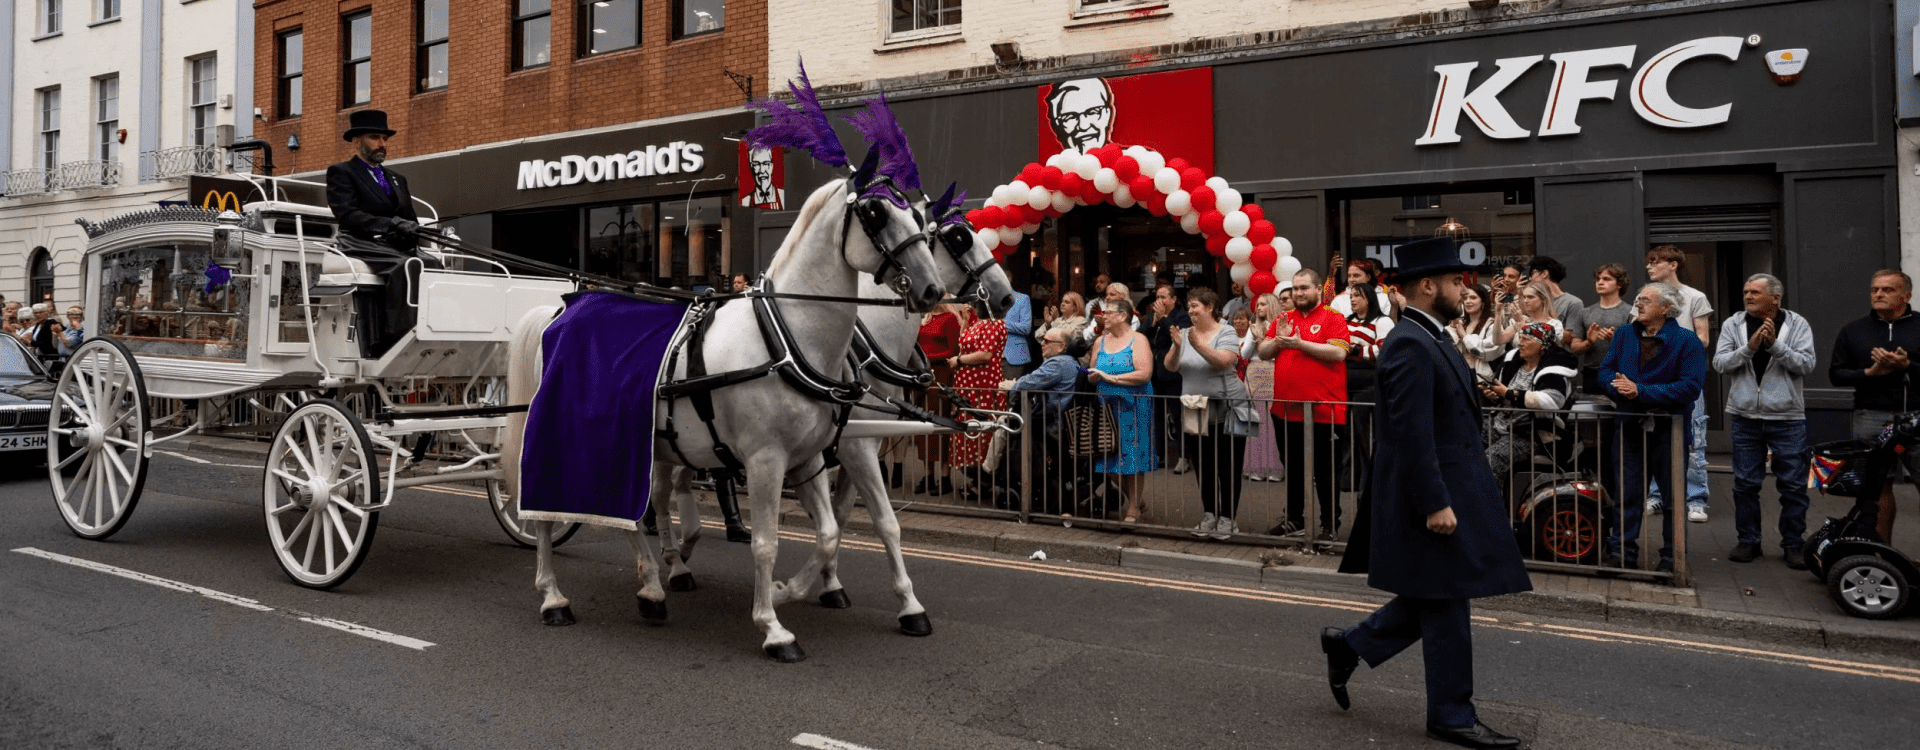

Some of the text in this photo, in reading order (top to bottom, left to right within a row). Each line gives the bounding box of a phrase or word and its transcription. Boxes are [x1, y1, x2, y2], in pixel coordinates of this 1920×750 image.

[1415, 36, 1744, 145] KFC
[517, 141, 704, 190] McDonald's
[0, 436, 48, 448] 24 SHM
